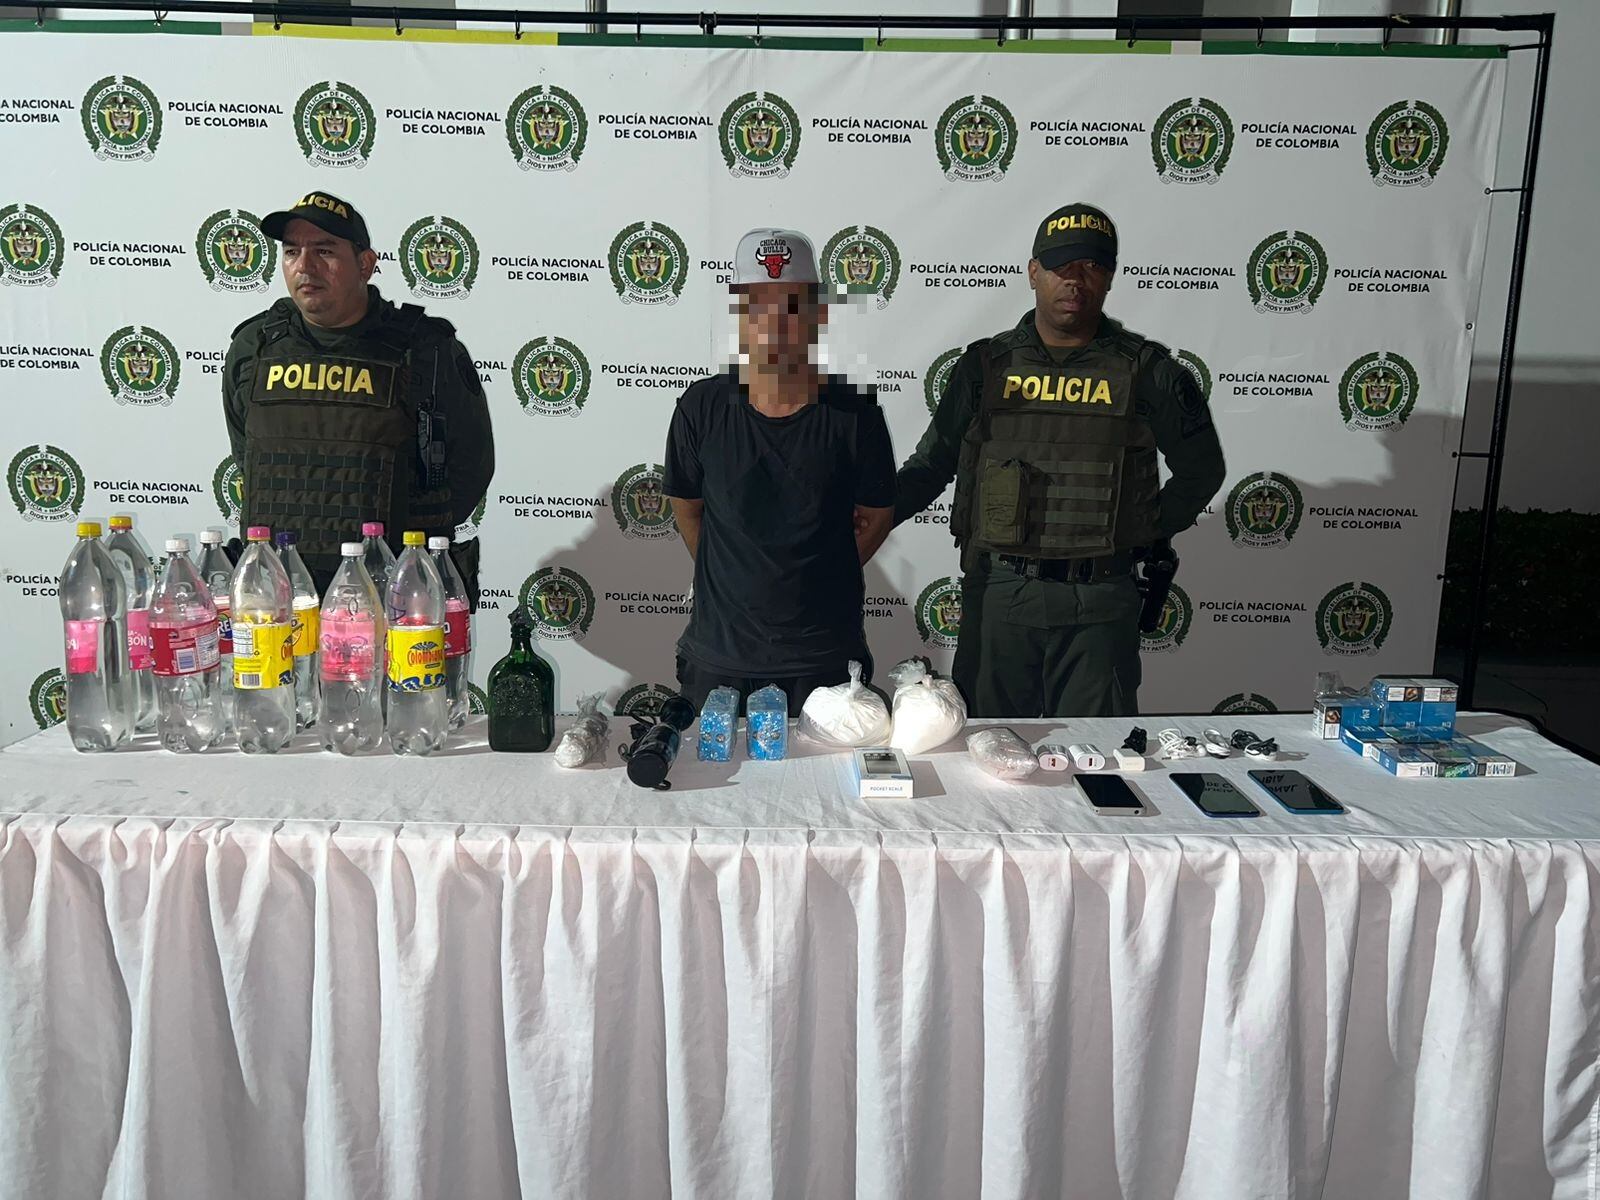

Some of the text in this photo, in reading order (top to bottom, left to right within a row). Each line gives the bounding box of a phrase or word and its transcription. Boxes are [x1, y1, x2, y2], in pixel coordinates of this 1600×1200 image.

[13, 100, 75, 109] NACIONAL
[132, 90, 152, 123] COLOMBIA
[168, 100, 283, 114] POLICÍA NACIONAL
[386, 108, 501, 121] POLICÍA NACIONAL
[599, 113, 713, 126] POLICÍA NACIONAL
[185, 116, 268, 128] DE COLOMBIA
[772, 106, 790, 140] COLOMBIA
[813, 116, 928, 129] POLICÍA NACIONAL
[1030, 120, 1146, 132] POLICÍA NACIONAL
[403, 124, 485, 135] DE COLOMBIA
[615, 129, 697, 139] DE COLOMBIA
[1241, 122, 1357, 136] POLICÍA NACIONAL
[1422, 114, 1438, 149] COLOMBIA
[96, 131, 150, 150] POLICIA NACIONAL
[828, 133, 911, 143] DE COLOMBIA
[1046, 136, 1128, 146] DE COLOMBIA
[1256, 136, 1339, 148] DE COLOMBIA
[125, 150, 145, 159] PATRIA
[733, 147, 788, 167] POLICIA NACIONAL
[760, 167, 780, 176] PATRIA
[1378, 156, 1433, 176] POLICIA NACIONAL
[1403, 175, 1425, 184] PATRIA
[297, 195, 348, 219] LICIA
[73, 241, 186, 254] POLICÍA NACIONAL
[760, 239, 787, 247] CHICAGO
[660, 235, 679, 268] COLOMBIA
[763, 246, 784, 254] BULLS
[90, 256, 171, 267] DE COLOMBIA
[492, 256, 604, 268] POLICÍA NACIONAL
[701, 261, 734, 270] POLIC
[910, 262, 1023, 274] POLICÍA NACIONAL
[1123, 264, 1236, 276] POLICÍA NACIONAL
[1334, 267, 1447, 279] POLICÍA NACIONAL
[508, 271, 589, 282] DE COLOMBIA
[716, 275, 731, 284] DE
[622, 275, 676, 294] POLICIA NACIONAL
[925, 278, 1006, 287] DE COLOMBIA
[1138, 278, 1219, 289] DE COLOMBIA
[1348, 282, 1430, 292] DE COLOMBIA
[649, 294, 669, 303] PATRIA
[0, 344, 94, 357] LICÍA NACIONAL
[186, 350, 224, 361] POLICÍ
[0, 360, 80, 370] DE COLOMBIA
[202, 365, 218, 374] DE
[474, 361, 507, 370] ONAL
[563, 349, 581, 382] COLOMBIA
[602, 363, 712, 376] POLICÍA NACIONAL
[266, 363, 374, 395] POLICIA
[617, 378, 632, 387] DE
[1219, 371, 1330, 385] POLICÍA NACIONAL
[1003, 375, 1113, 405] POLICIA
[1233, 386, 1313, 396] DE COLOMBIA
[526, 388, 579, 407] POLICIA NACIONAL
[552, 406, 573, 415] PATRIA
[94, 480, 203, 492] POLICÍA NACIONAL
[110, 494, 189, 504] DE COLOMBIA
[499, 494, 608, 507] POLICÍA NACIONAL
[515, 507, 593, 519] DE COLOMBIA
[1310, 505, 1418, 517] POLICÍA NACIONAL
[915, 516, 929, 524] DE
[1323, 520, 1402, 529] DE COLOMBIA
[7, 574, 51, 585] POLICÍA
[23, 588, 37, 596] DE
[479, 589, 514, 598] IONAL
[605, 591, 650, 602] POLICÍA
[864, 597, 908, 606] CIONAL
[1200, 600, 1307, 611] POLICÍA NACIONAL
[620, 605, 634, 613] DE
[1213, 614, 1290, 623] DE COLOMBIA
